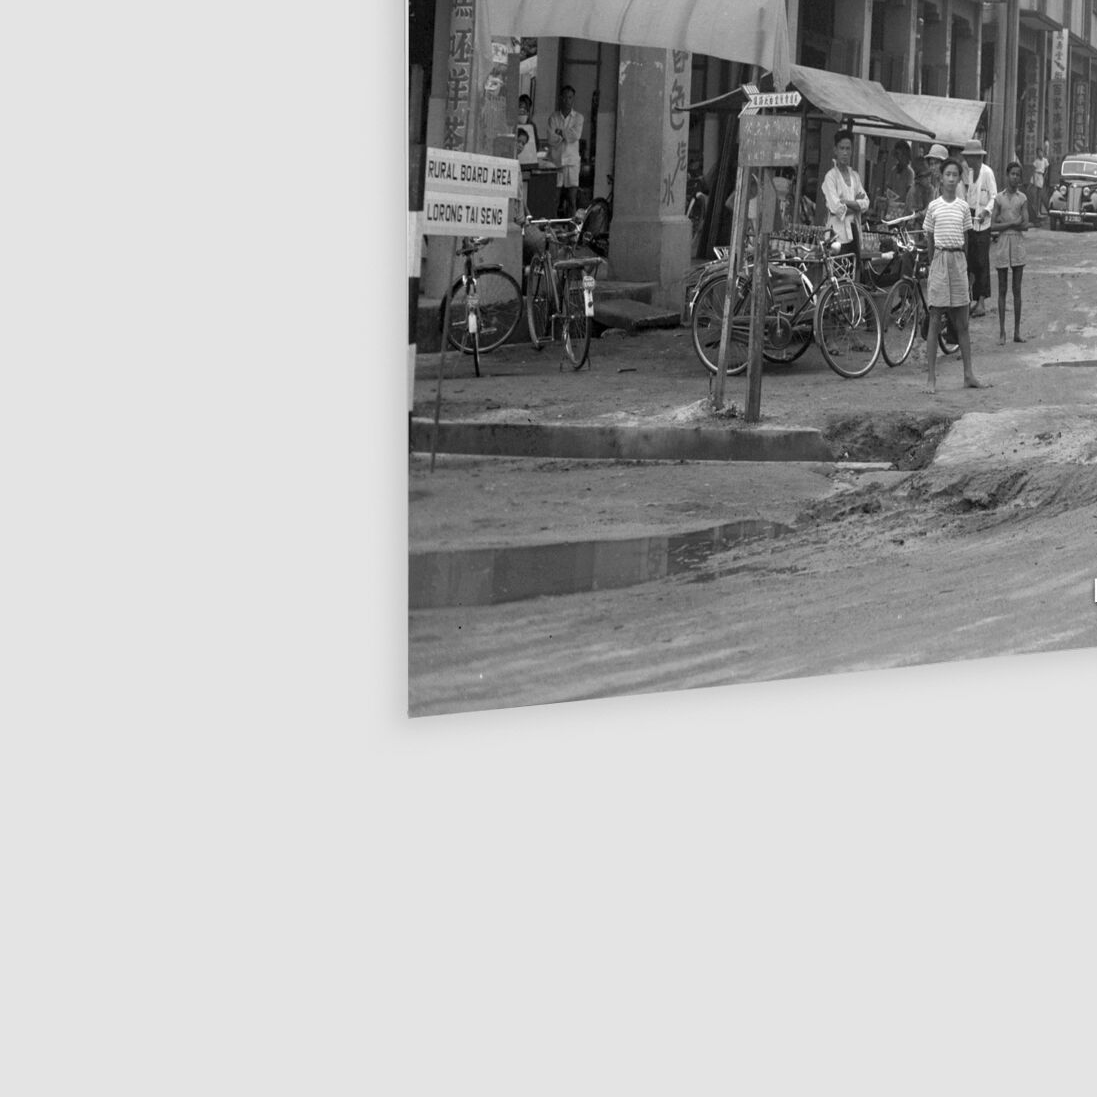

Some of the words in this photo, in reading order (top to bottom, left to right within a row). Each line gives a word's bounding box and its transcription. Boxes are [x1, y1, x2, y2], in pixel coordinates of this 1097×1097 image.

[428, 160, 457, 180] RURAL
[461, 164, 488, 183] BOARD
[491, 168, 512, 185] AREA
[427, 203, 463, 222] LORONG
[465, 205, 479, 223] TAI
[481, 207, 503, 225] SENG
